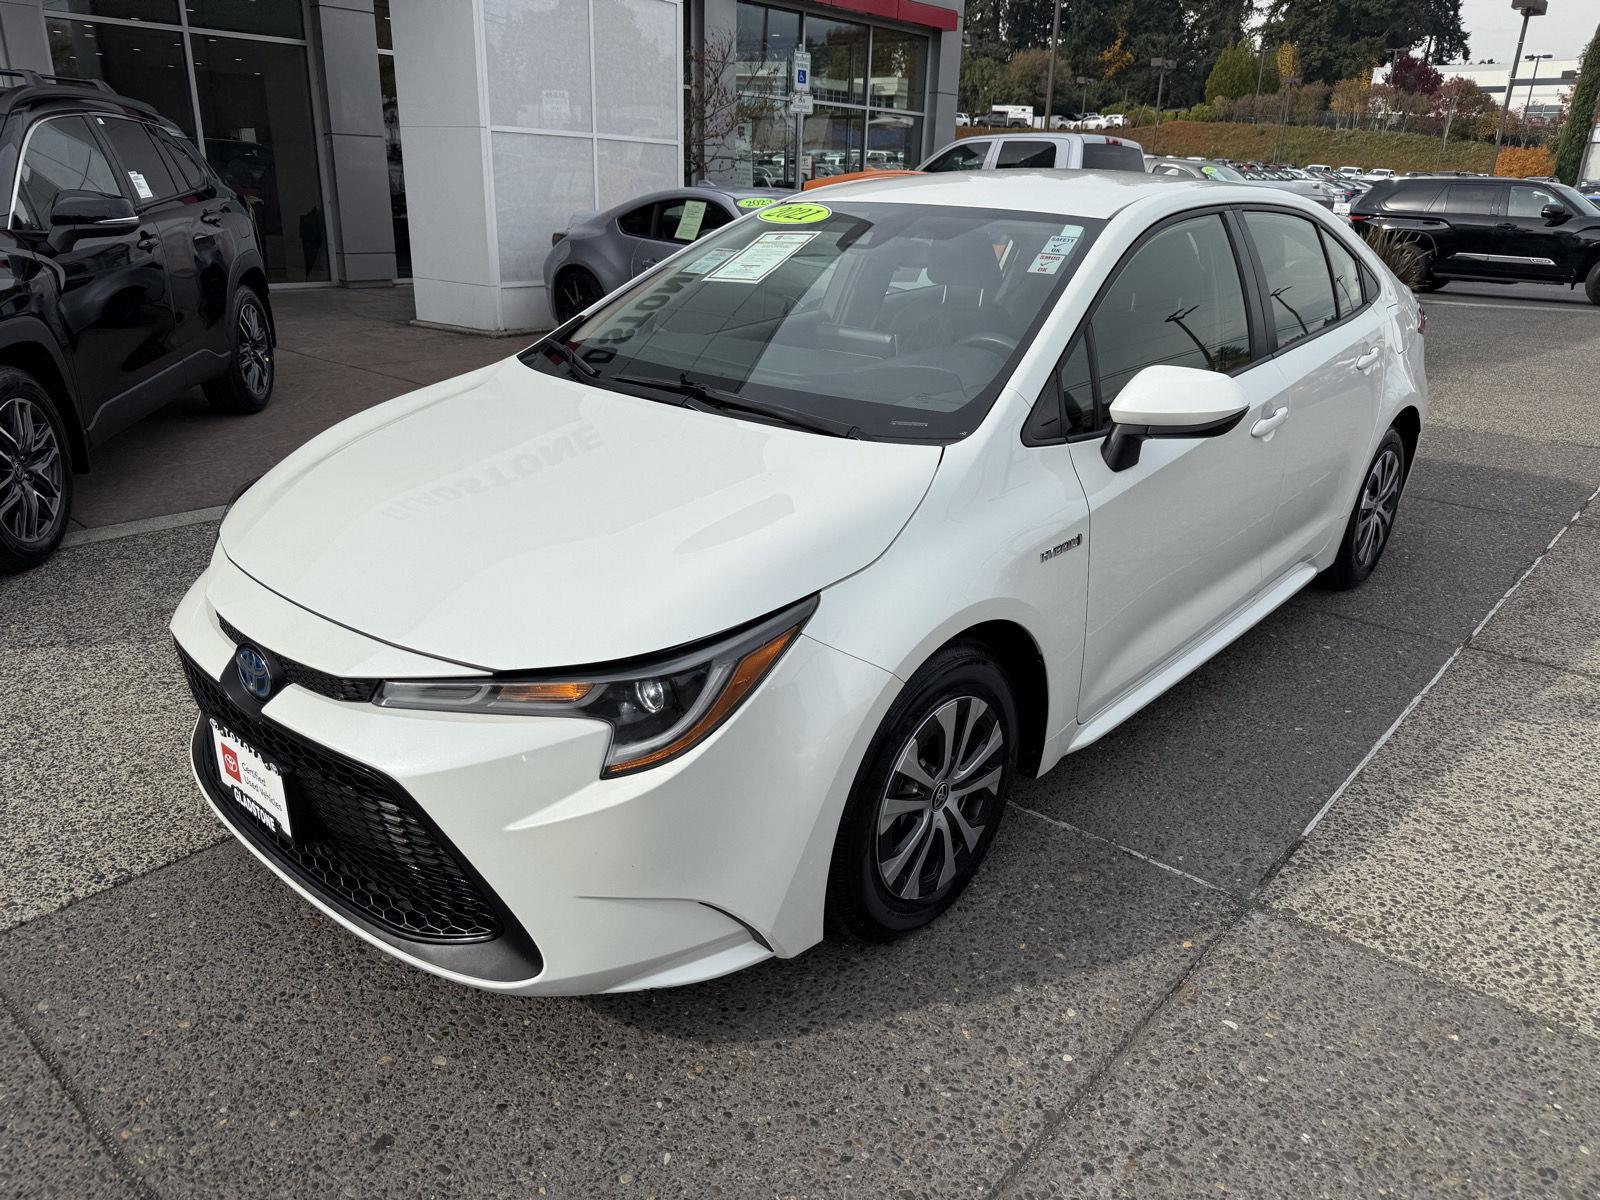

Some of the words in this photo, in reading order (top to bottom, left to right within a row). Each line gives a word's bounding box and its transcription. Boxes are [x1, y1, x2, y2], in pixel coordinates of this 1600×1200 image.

[1040, 533, 1083, 563] HYBRID
[241, 762, 267, 786] Certified
[233, 787, 277, 833] GLADSTONE
[243, 775, 259, 793] Used
[258, 786, 283, 812] Vehicles
